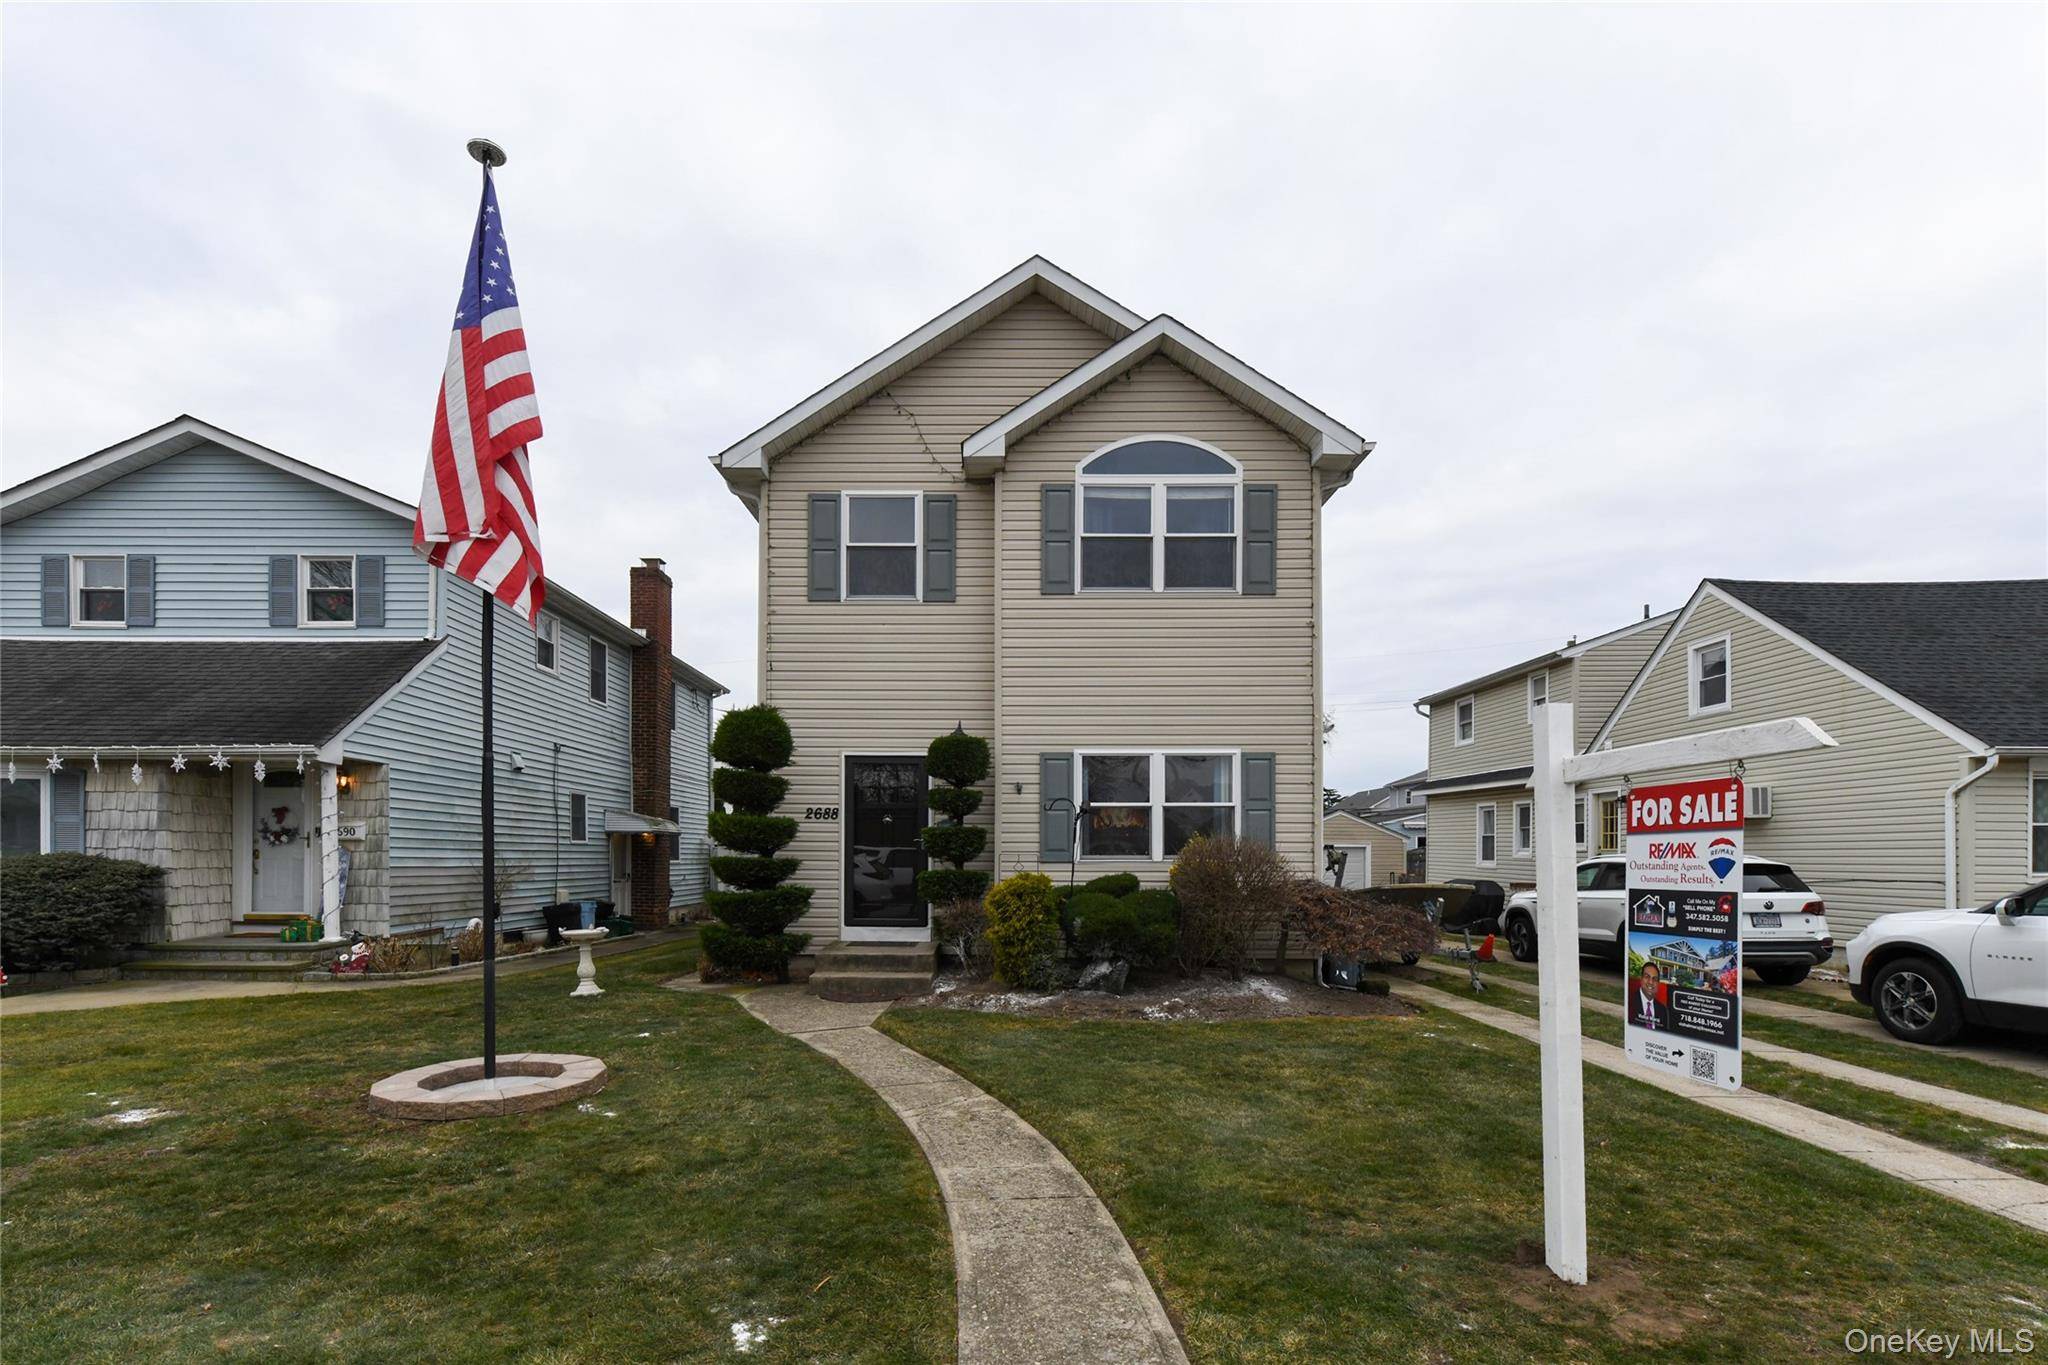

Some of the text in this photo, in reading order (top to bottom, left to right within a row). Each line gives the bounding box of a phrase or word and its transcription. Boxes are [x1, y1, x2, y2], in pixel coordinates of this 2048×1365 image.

[805, 807, 839, 820] 2688
[1631, 790, 1738, 827] FOR SALE
[1649, 842, 1697, 859] RE/MAX
[1710, 848, 1735, 856] RE/MAX
[1629, 860, 1679, 872] Outstanding
[1640, 874, 1679, 884] Outstanding
[1685, 913, 1729, 922] 347.582.5058
[1680, 1014, 1723, 1029] 718.848.1966
[1645, 1041, 1667, 1051] DISCOVER
[1654, 1050, 1668, 1058] VALUE
[1665, 1060, 1679, 1068] HOME
